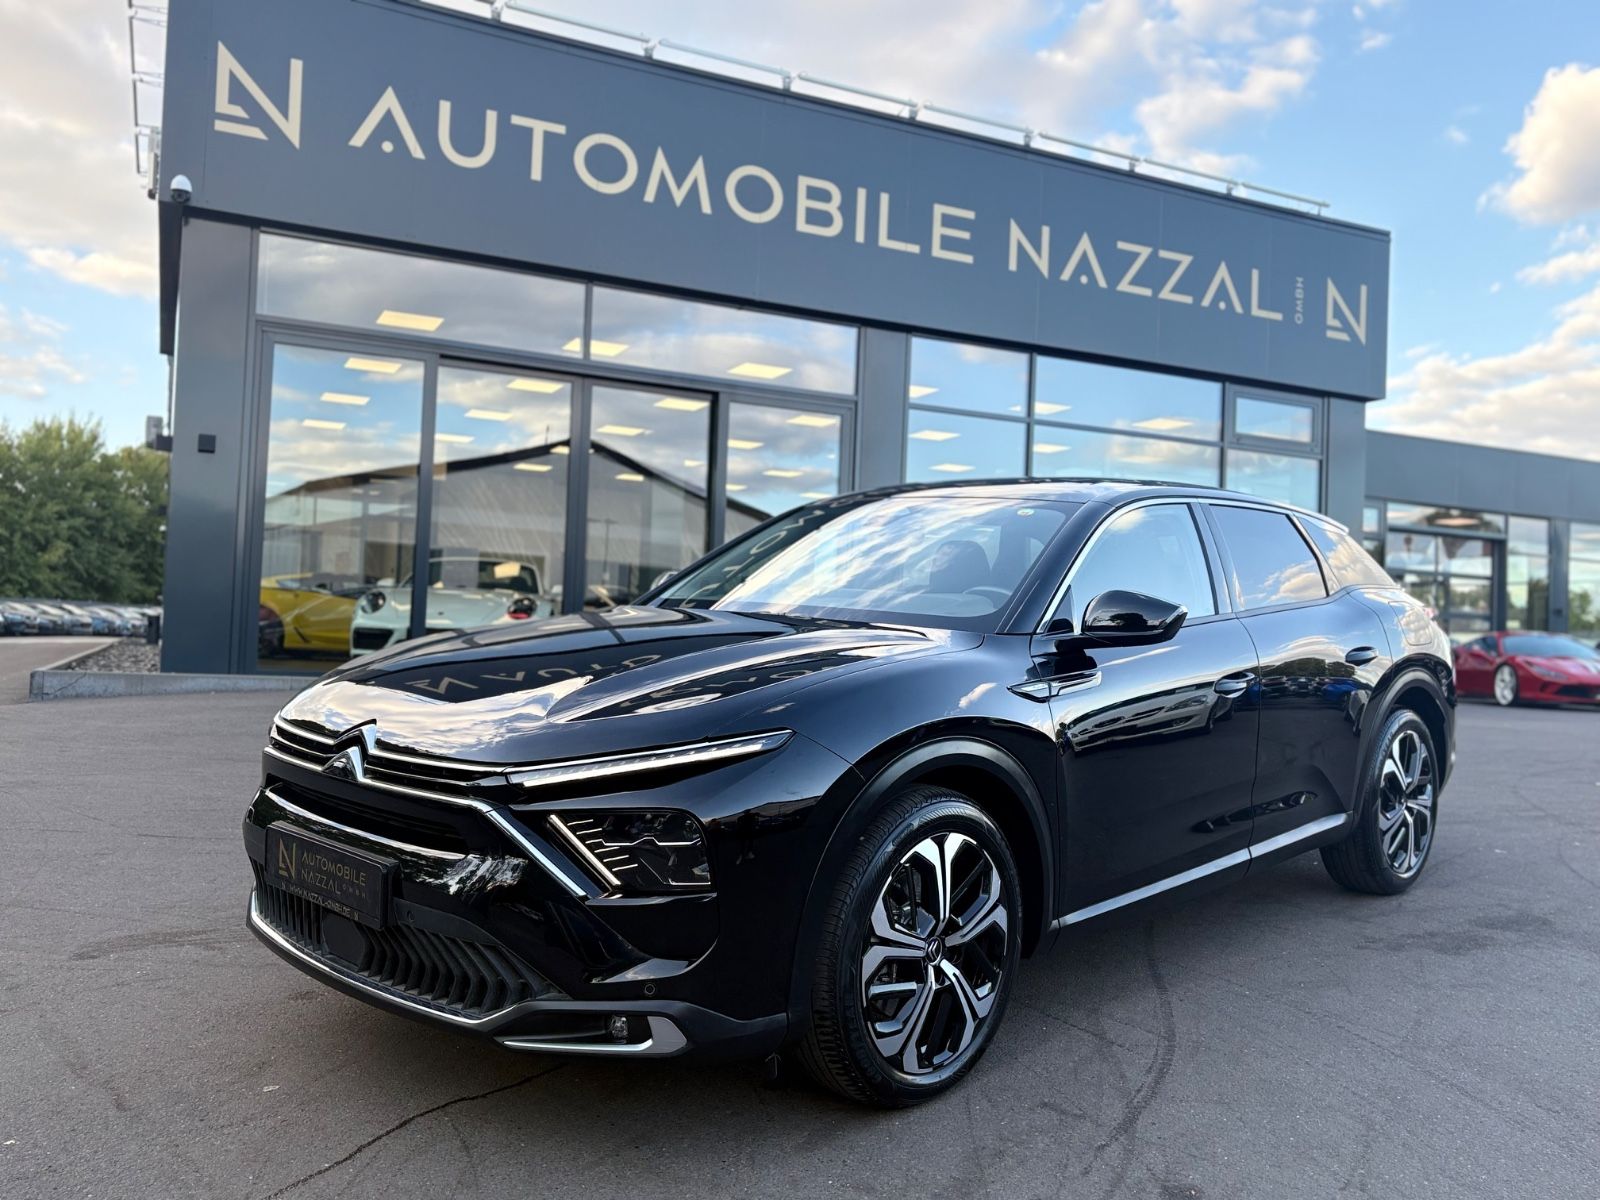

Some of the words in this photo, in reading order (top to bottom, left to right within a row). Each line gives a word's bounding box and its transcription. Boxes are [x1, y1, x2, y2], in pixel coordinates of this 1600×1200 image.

[347, 86, 976, 264] AUTOMOBILE
[1007, 217, 1284, 322] NAZZAL
[301, 850, 367, 887] AUTOMOBILE
[301, 868, 341, 895] NAZZAL
